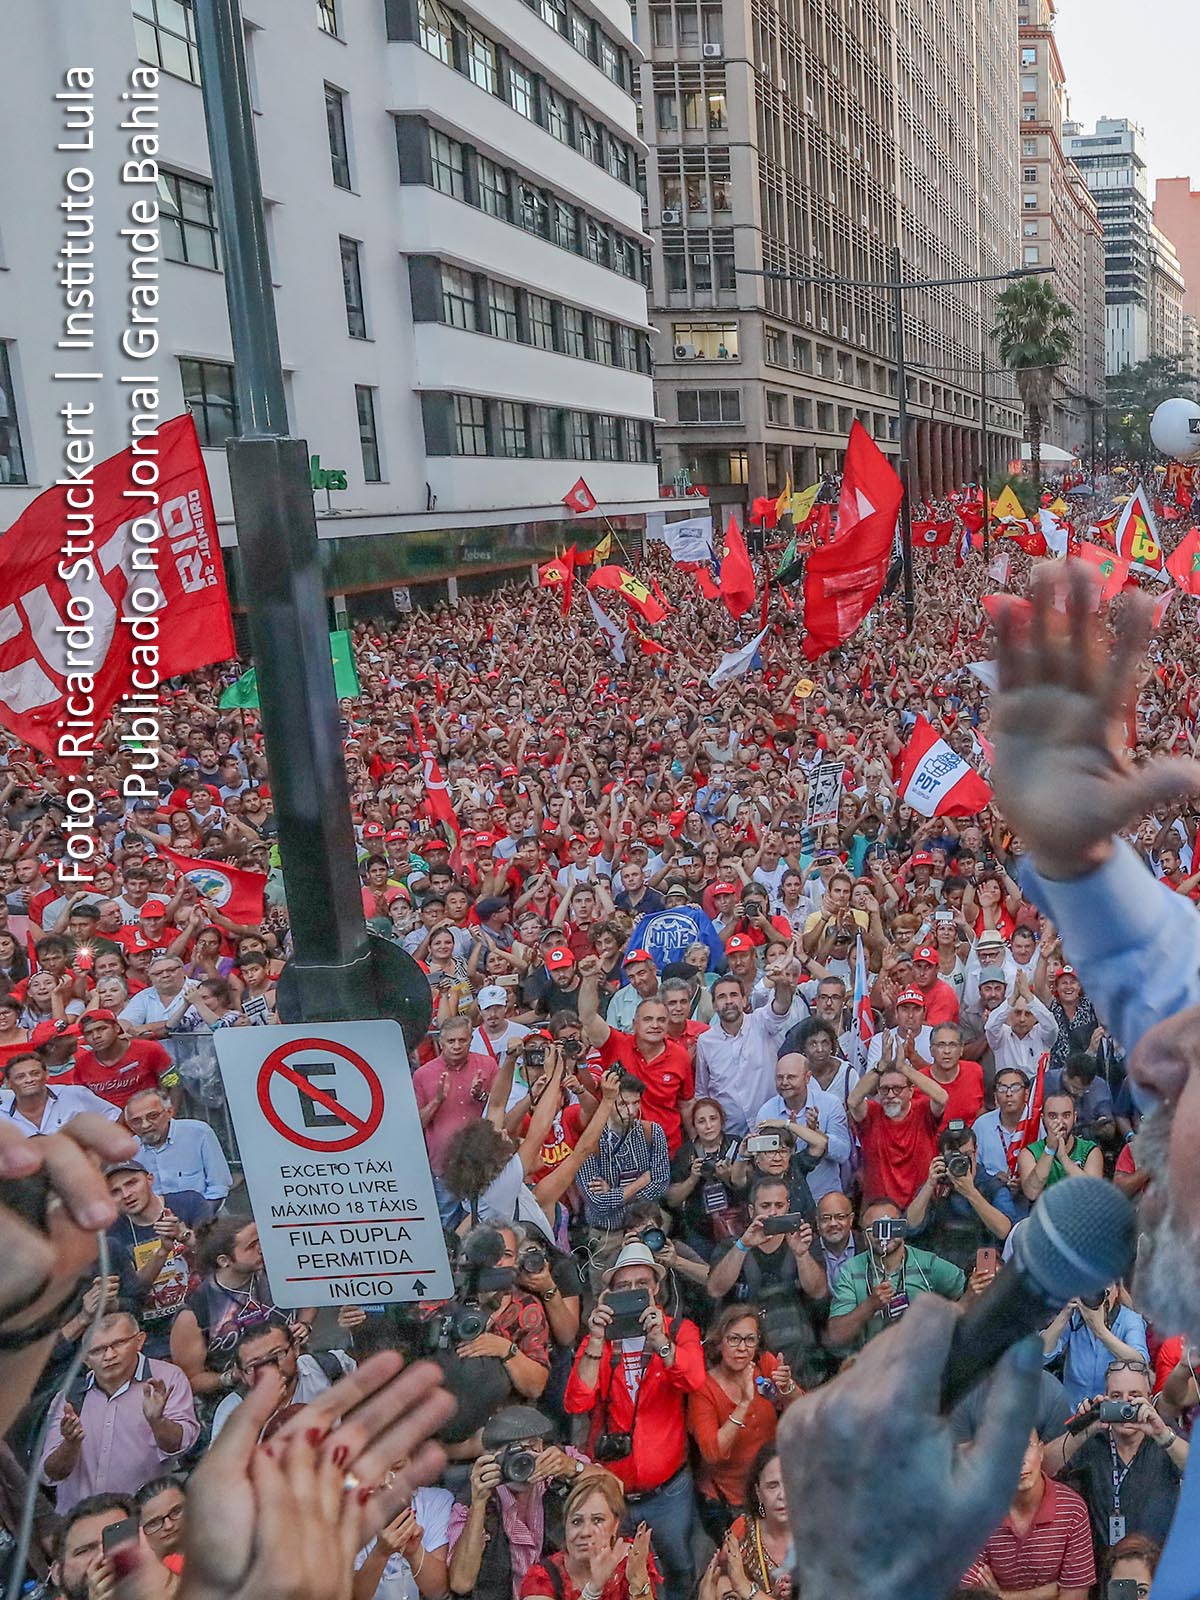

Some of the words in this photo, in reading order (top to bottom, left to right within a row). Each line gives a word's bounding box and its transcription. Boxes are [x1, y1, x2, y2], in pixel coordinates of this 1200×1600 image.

[187, 489, 211, 563] JANEIRO
[161, 495, 208, 594] RIO
[204, 563, 218, 587] DE
[914, 772, 941, 793] PDT
[653, 929, 690, 949] UNE
[293, 1063, 347, 1128] E
[280, 1163, 351, 1179] EXCETO
[355, 1159, 393, 1174] TÁXI
[284, 1182, 344, 1197] PONTO
[349, 1180, 398, 1195] LIVRE
[271, 1201, 341, 1218] MÁXIMO
[346, 1202, 365, 1214] 18
[368, 1199, 418, 1212] TÁXIS
[289, 1230, 335, 1247] FILA
[340, 1226, 412, 1244] DUPLA
[297, 1249, 413, 1270] PERMITIDA
[329, 1280, 393, 1299] INÍCIO
